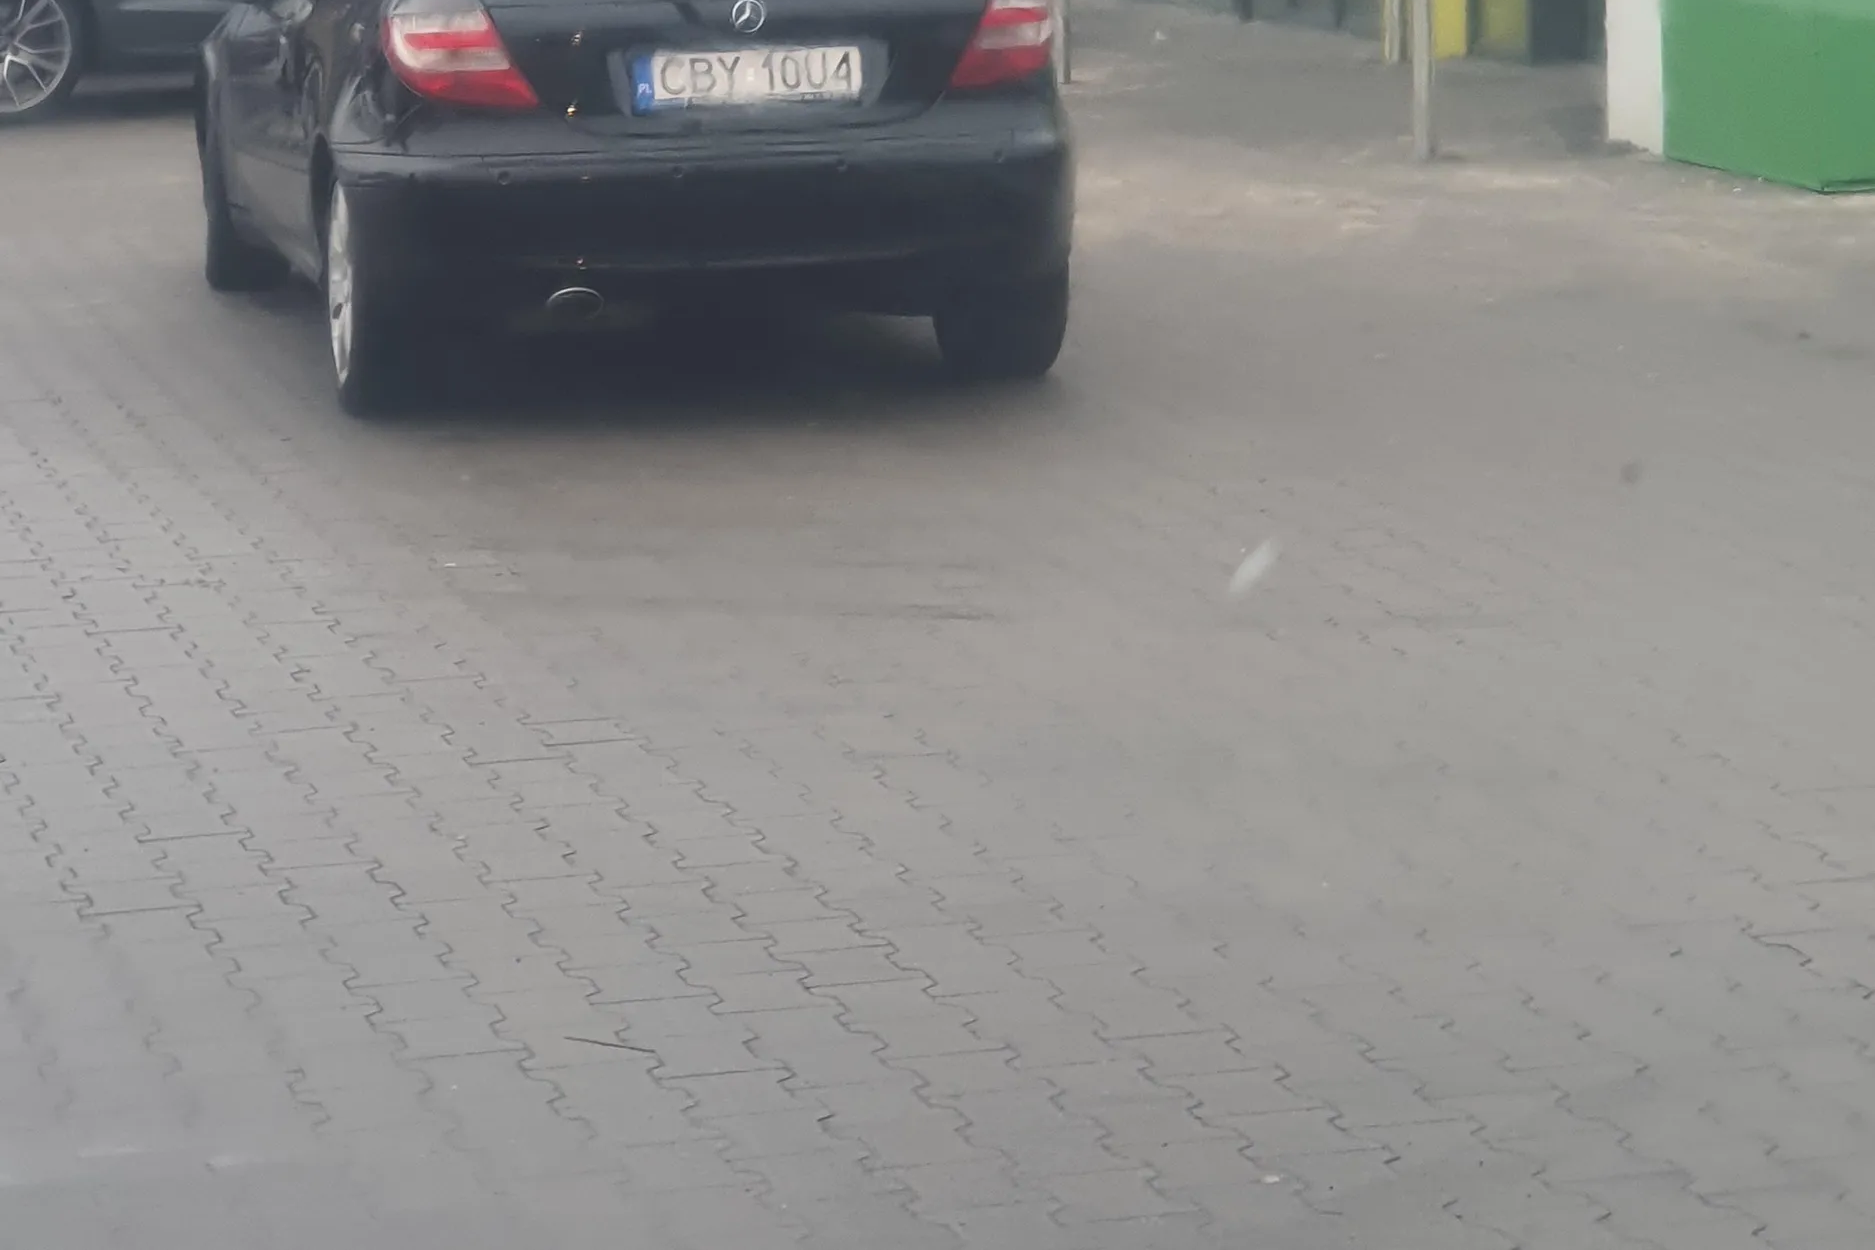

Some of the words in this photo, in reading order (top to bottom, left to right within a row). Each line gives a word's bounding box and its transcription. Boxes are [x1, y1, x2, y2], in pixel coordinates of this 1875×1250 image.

[659, 55, 741, 96] CBY
[761, 50, 853, 92] 10U4
[638, 82, 652, 94] PL
